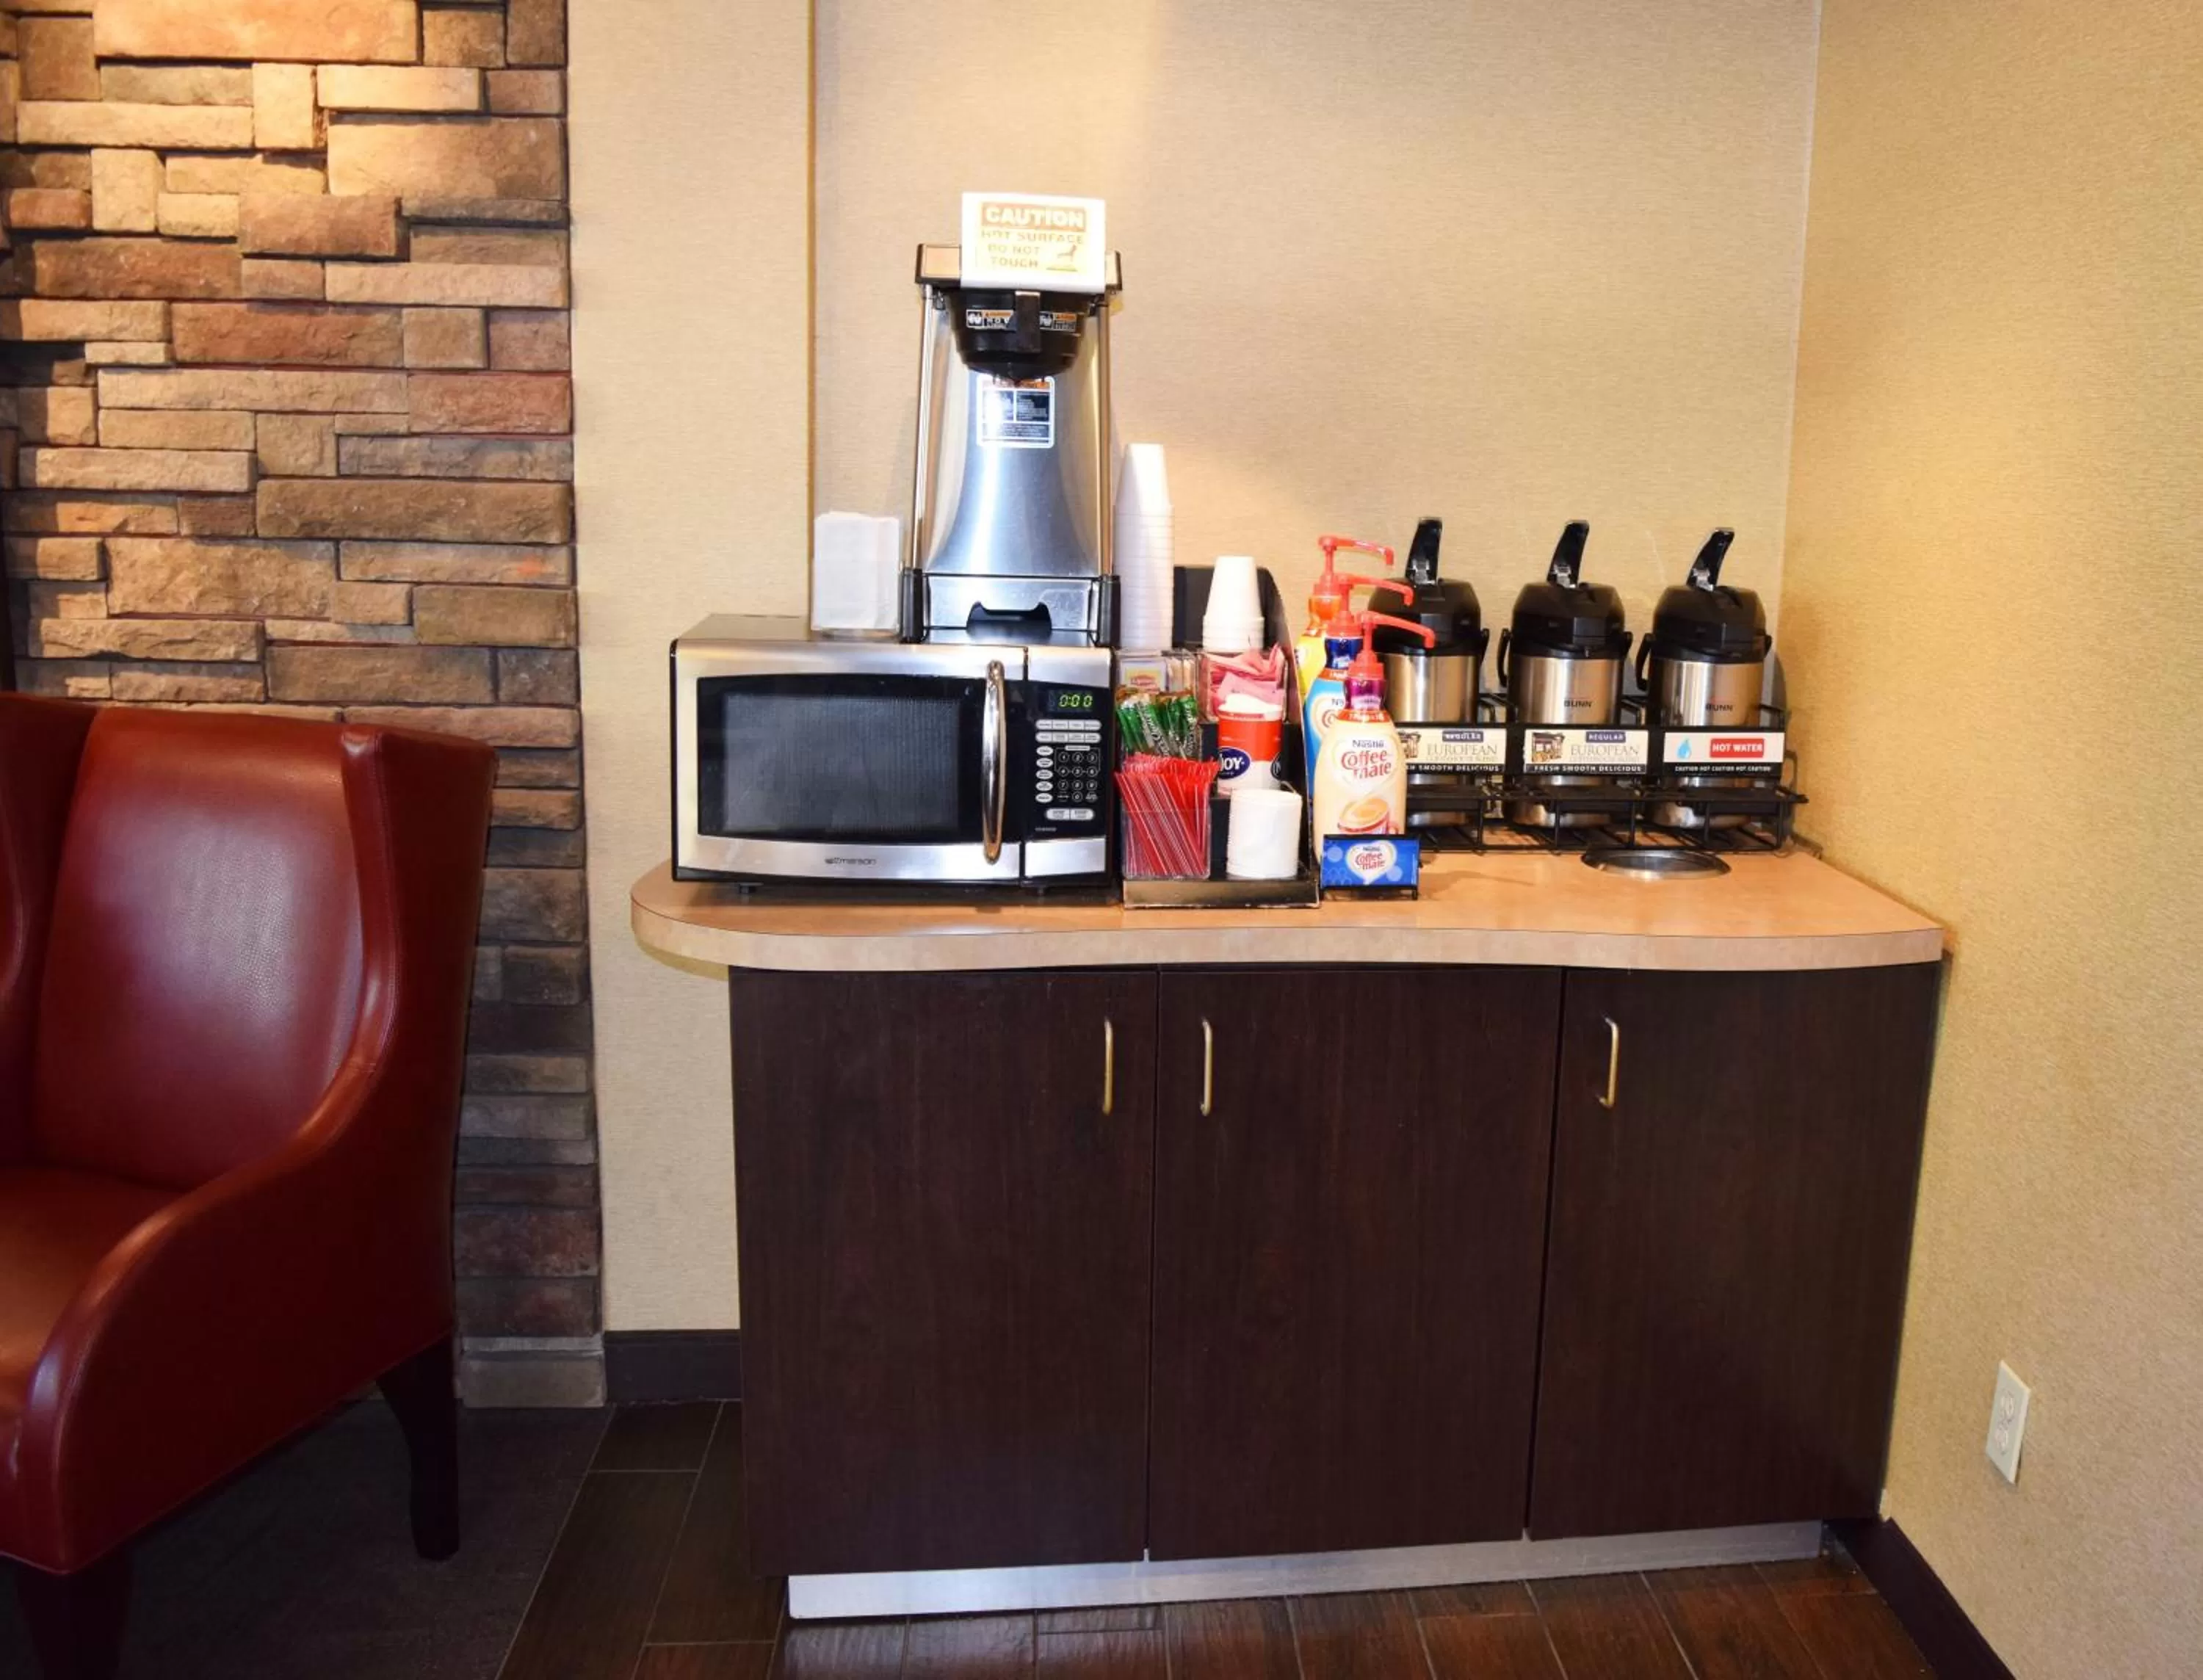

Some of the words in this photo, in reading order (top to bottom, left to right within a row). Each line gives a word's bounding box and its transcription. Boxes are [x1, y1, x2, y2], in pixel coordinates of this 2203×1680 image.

[985, 206, 1084, 229] CAUTION
[981, 229, 1010, 239] HOT
[1018, 232, 1083, 245] SURFACE
[988, 244, 1007, 253] DO
[1013, 245, 1040, 256] NOT
[991, 256, 1039, 268] TOUCH
[1058, 695, 1093, 707] 0:00
[1564, 700, 1592, 708] BUNN
[1706, 703, 1733, 712] BUNN
[1427, 744, 1498, 756] EUROPEAN
[1571, 745, 1641, 756] EUROPEAN
[1712, 744, 1731, 753] HOT
[1732, 744, 1763, 753] WATER
